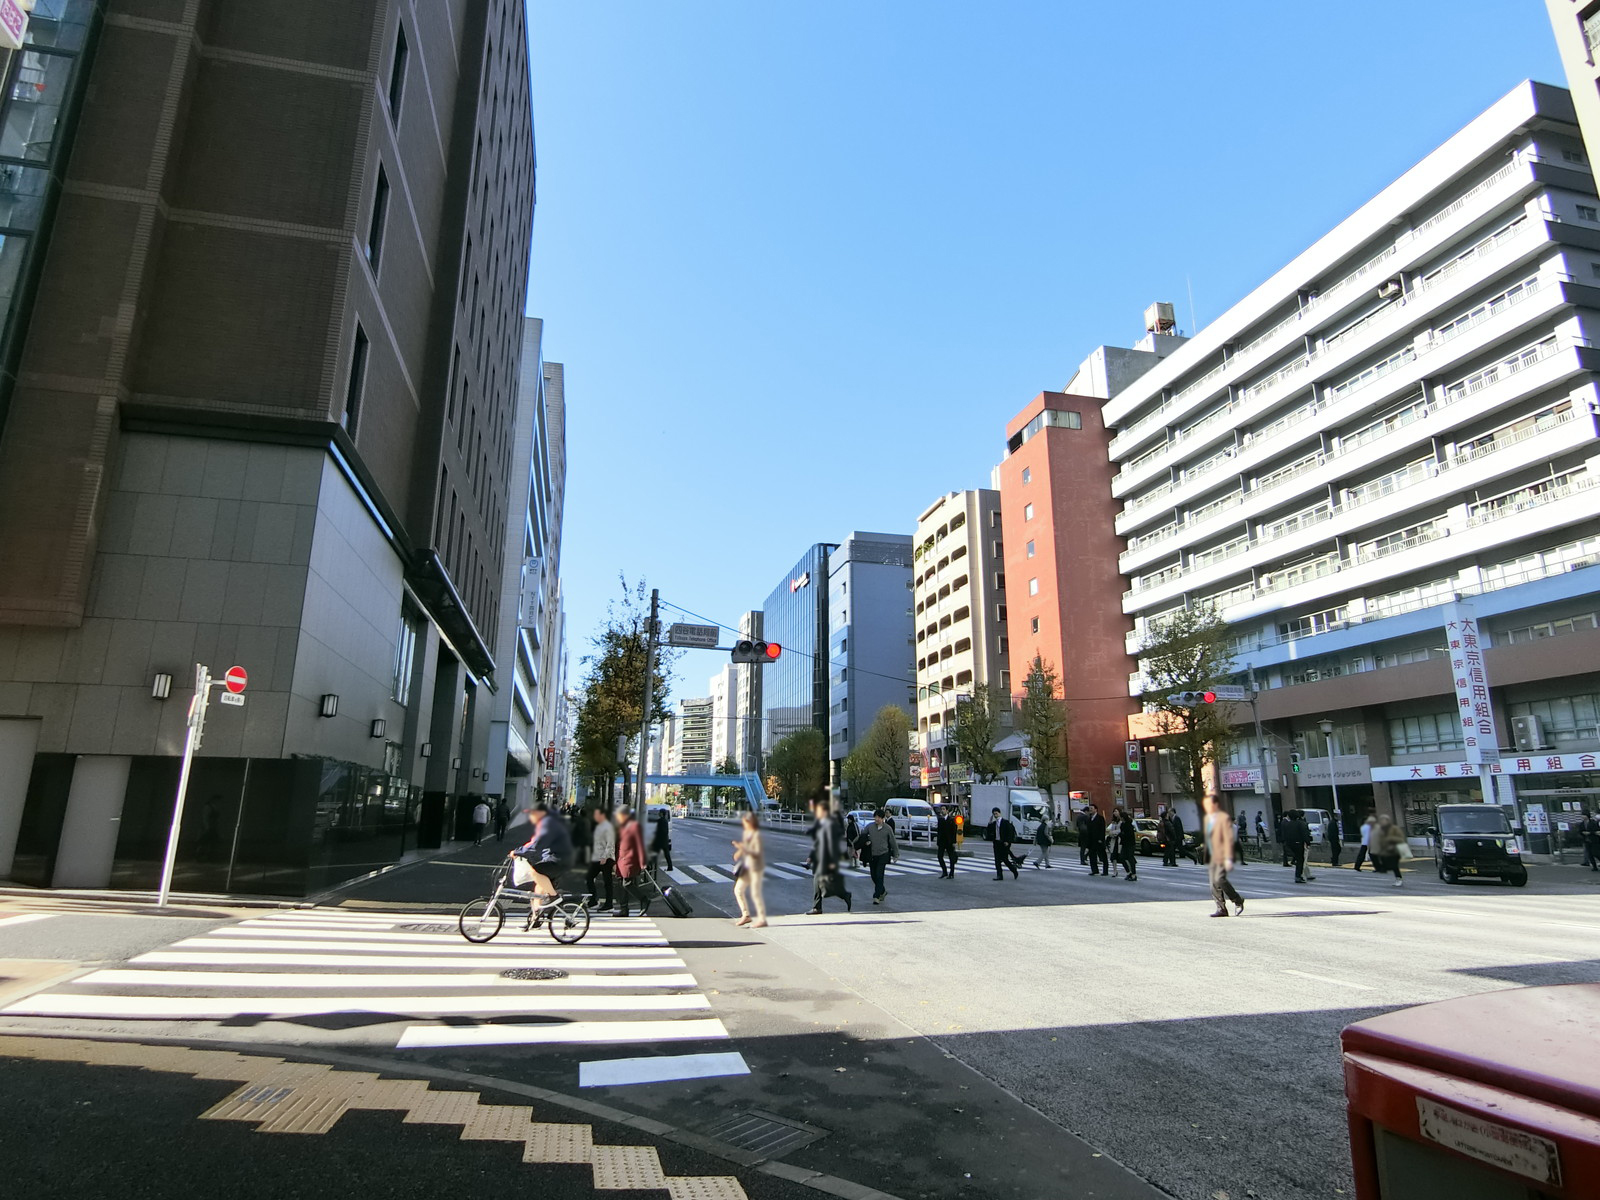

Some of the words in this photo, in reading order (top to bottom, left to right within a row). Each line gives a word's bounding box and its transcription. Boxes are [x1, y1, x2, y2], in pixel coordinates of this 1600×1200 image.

[1447, 621, 1477, 747] 大東京信用組合
[1461, 618, 1492, 735] 大東京信用組合
[1410, 754, 1597, 778] 大東京信用組合
